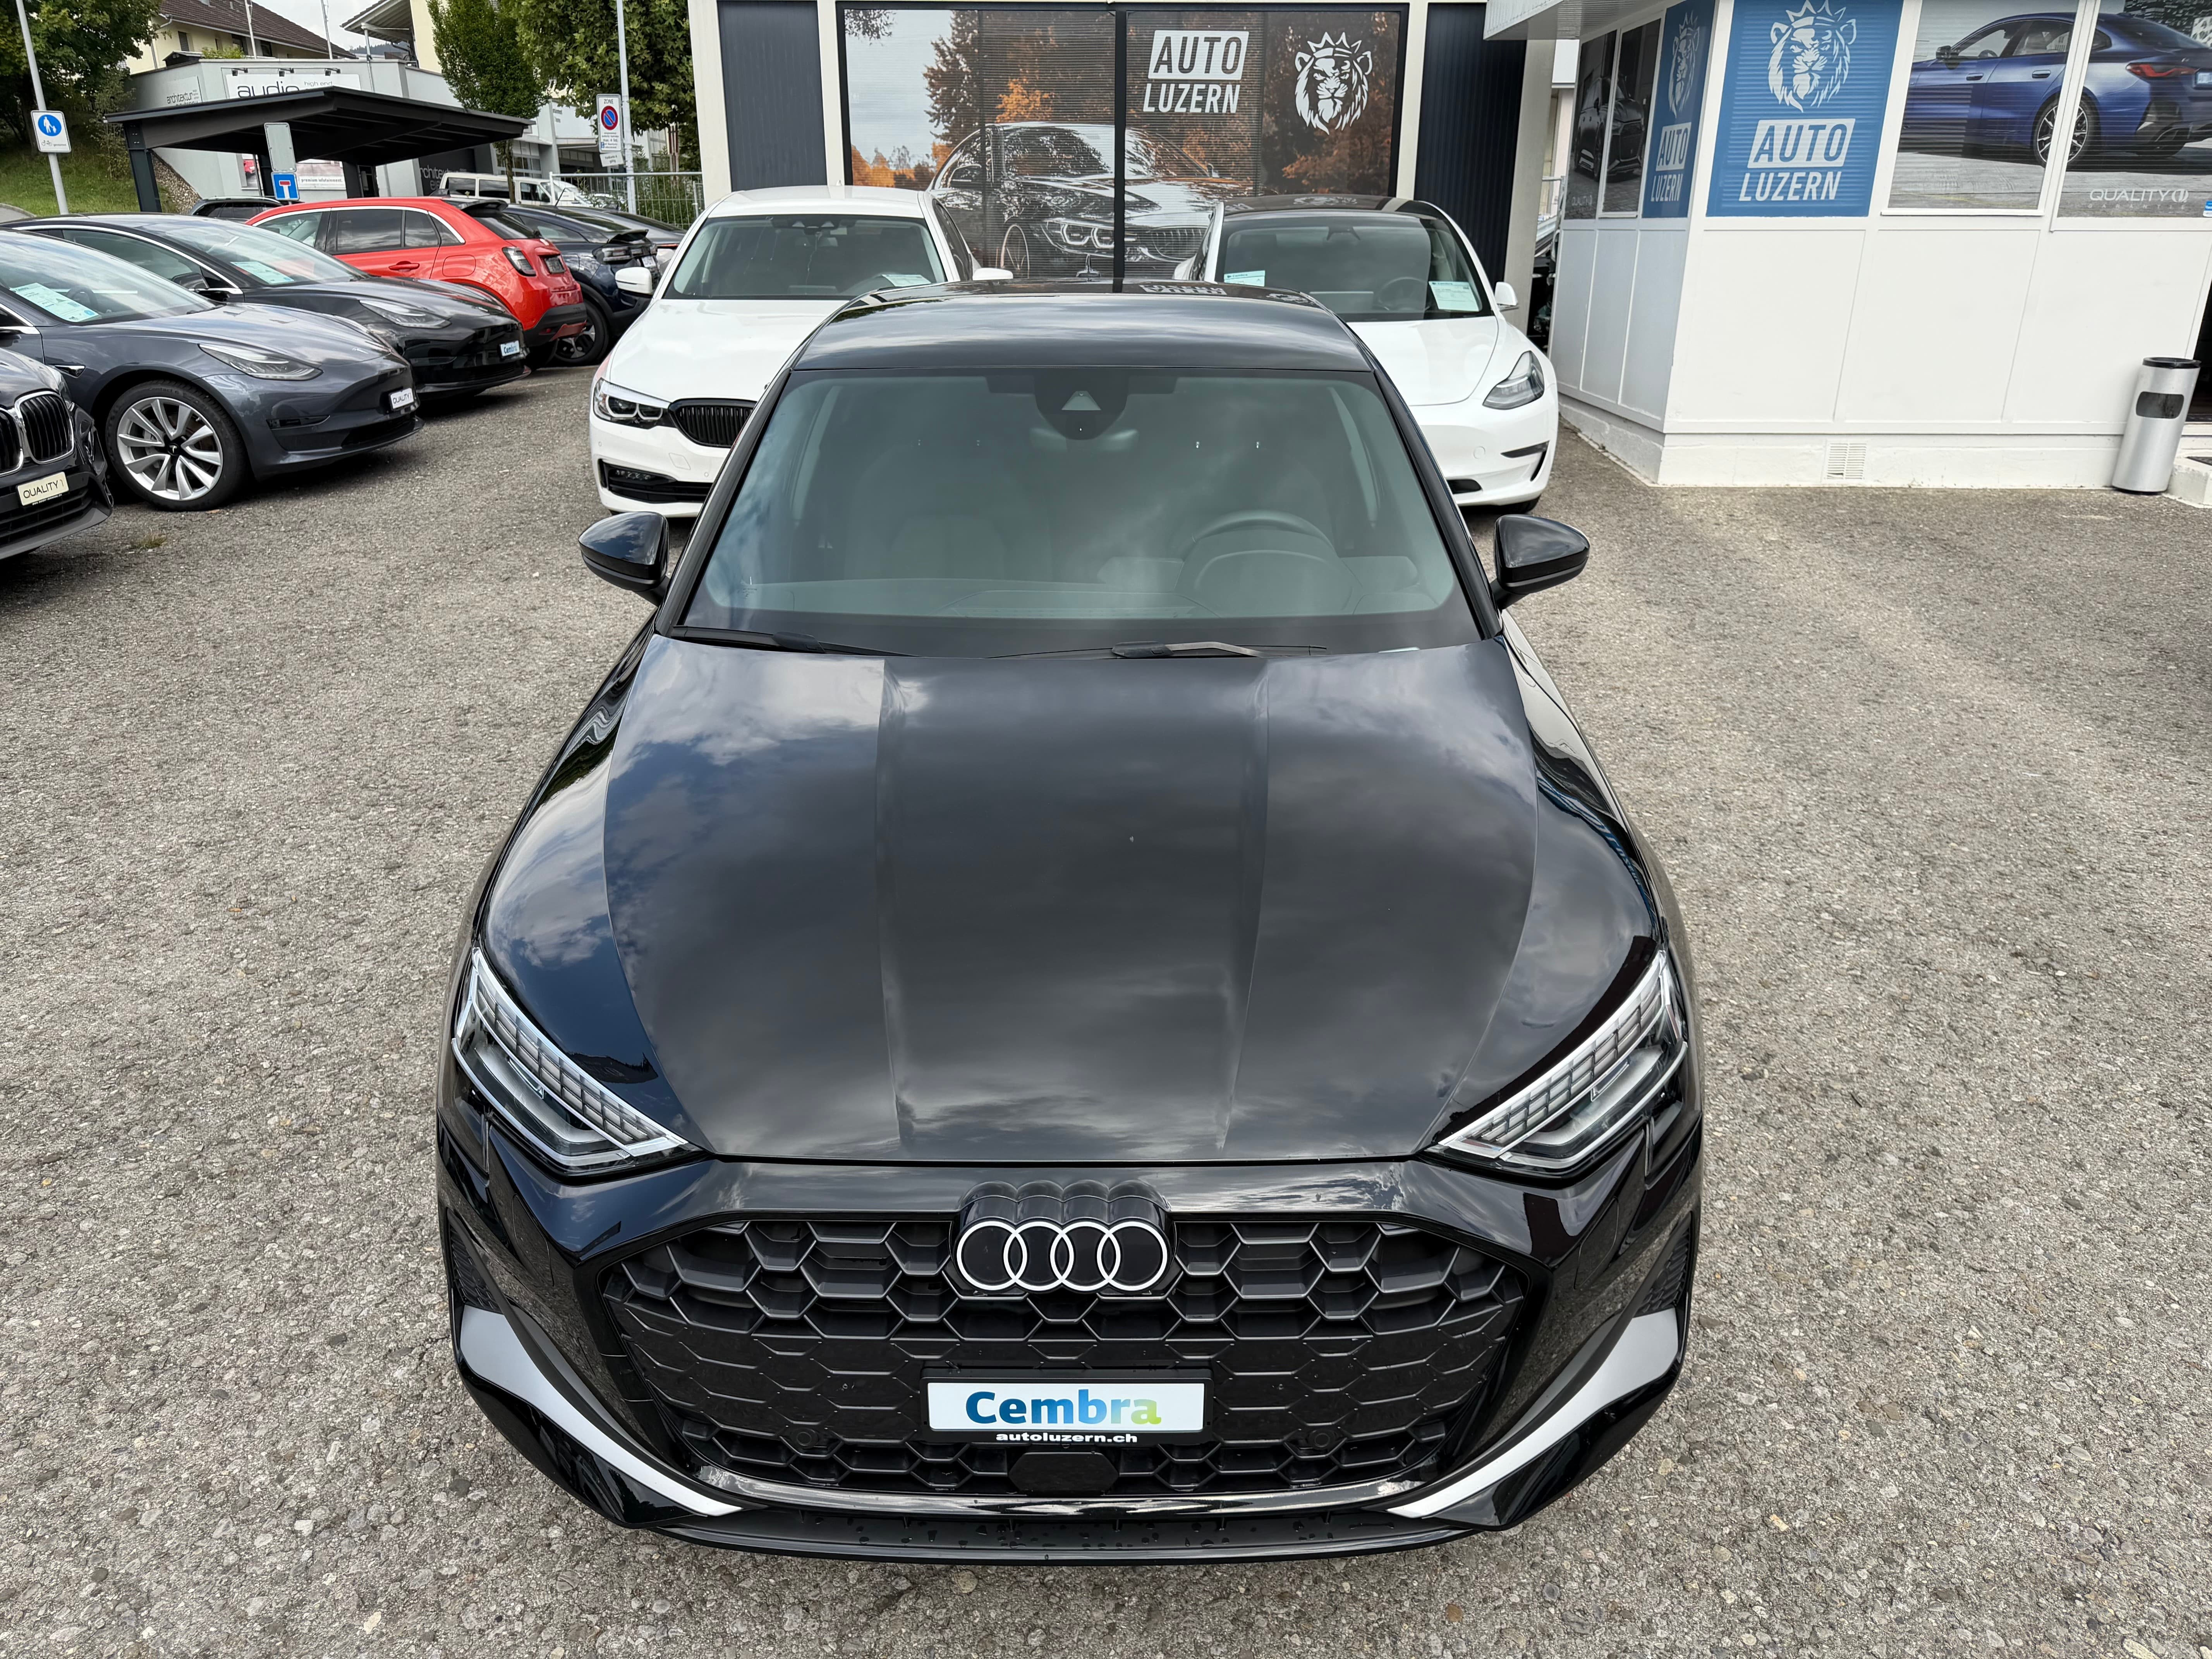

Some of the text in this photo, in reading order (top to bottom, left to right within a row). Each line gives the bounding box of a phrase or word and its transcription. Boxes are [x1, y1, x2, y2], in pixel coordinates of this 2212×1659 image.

[1153, 36, 1242, 74] AUTO
[1143, 83, 1240, 113] LUZERN
[1658, 128, 1688, 166] AUTO
[1753, 124, 1847, 162] AUTO
[1650, 173, 1683, 202] LUZERN
[1739, 171, 1841, 201] LUZERN
[2090, 189, 2172, 201] QUALITY
[23, 480, 58, 498] QUALITY
[966, 1389, 1161, 1424] Cembra
[996, 1433, 1137, 1443] autoluzern.ch
